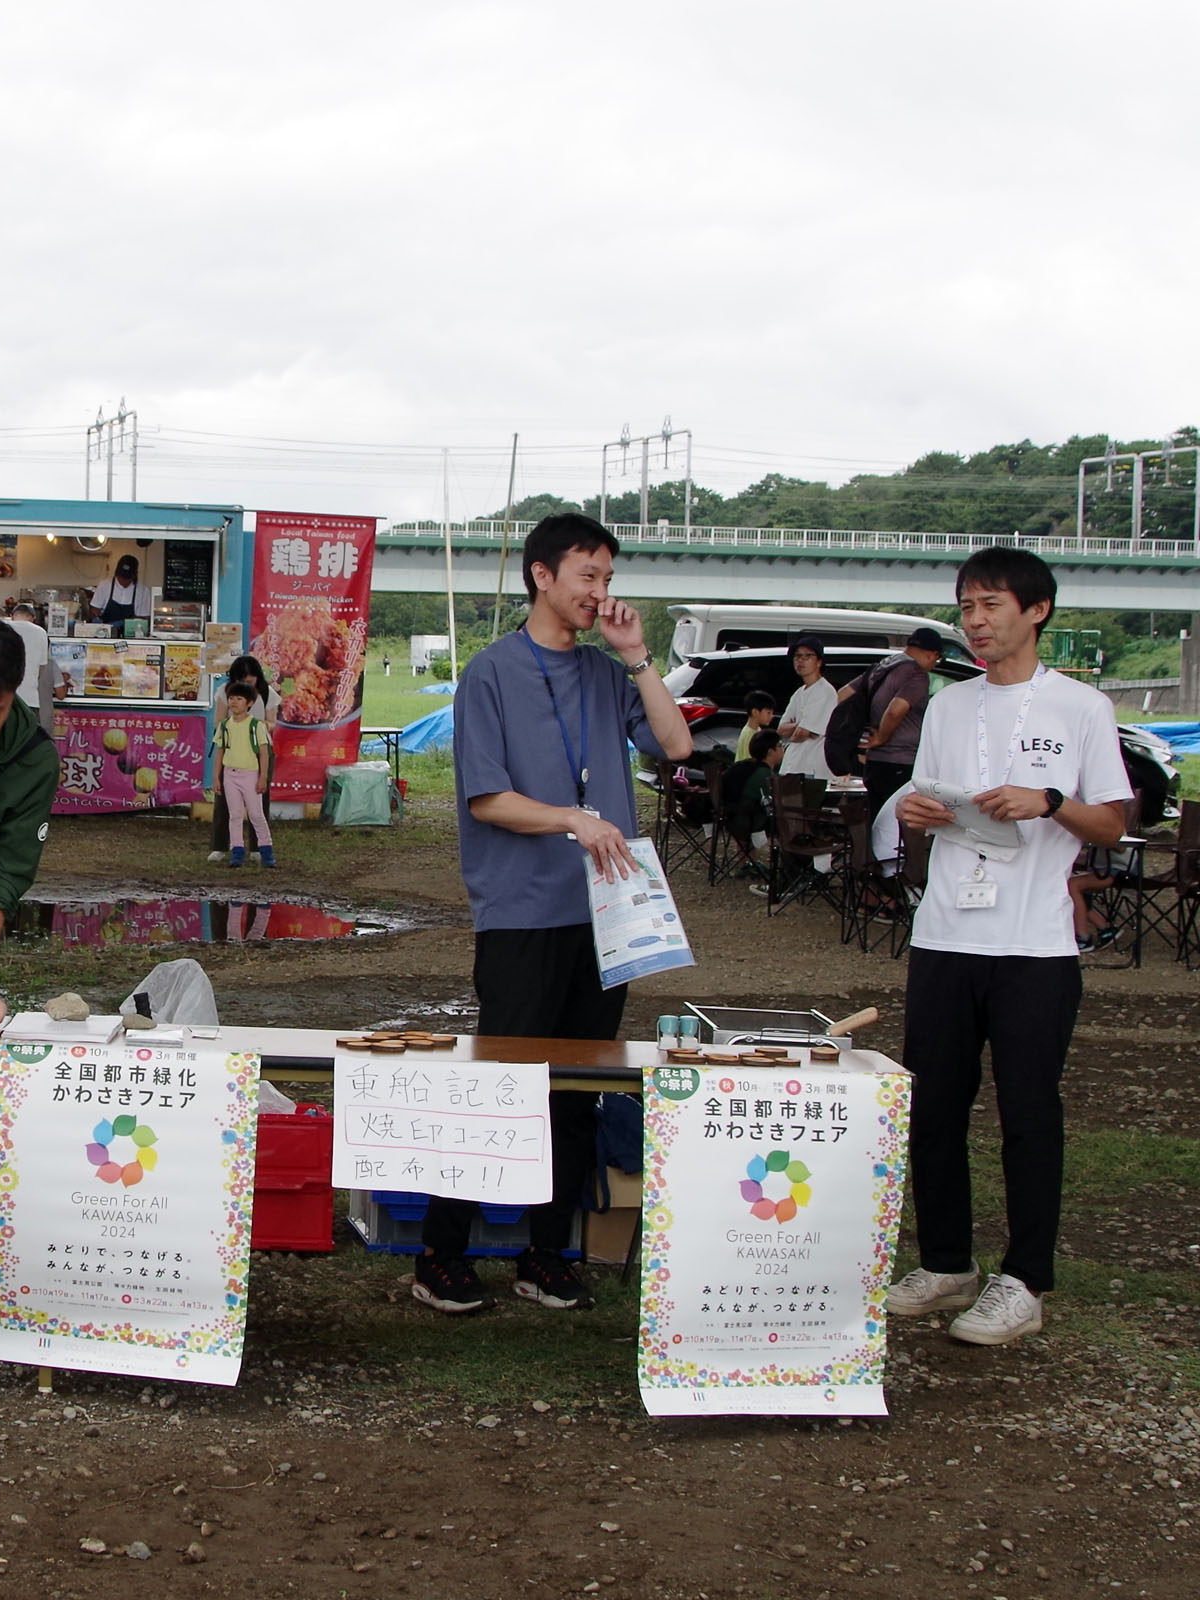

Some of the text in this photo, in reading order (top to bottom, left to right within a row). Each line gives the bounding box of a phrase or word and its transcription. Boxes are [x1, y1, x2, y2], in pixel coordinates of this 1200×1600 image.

[1021, 738, 1064, 754] LESS
[54, 1062, 198, 1088] 全国都市緑化
[52, 1084, 197, 1109] かわさきフェア
[703, 1097, 849, 1121] 全国都市緑化
[361, 1112, 538, 1148] 焼印コースター
[703, 1121, 848, 1143] かわさきフェア
[71, 1191, 168, 1210] Green For All
[81, 1209, 158, 1224] KAWASAKI
[100, 1225, 136, 1238] 2024
[726, 1229, 821, 1244] Green For All
[737, 1247, 810, 1260] KAWASAKI
[755, 1263, 788, 1275] 2024
